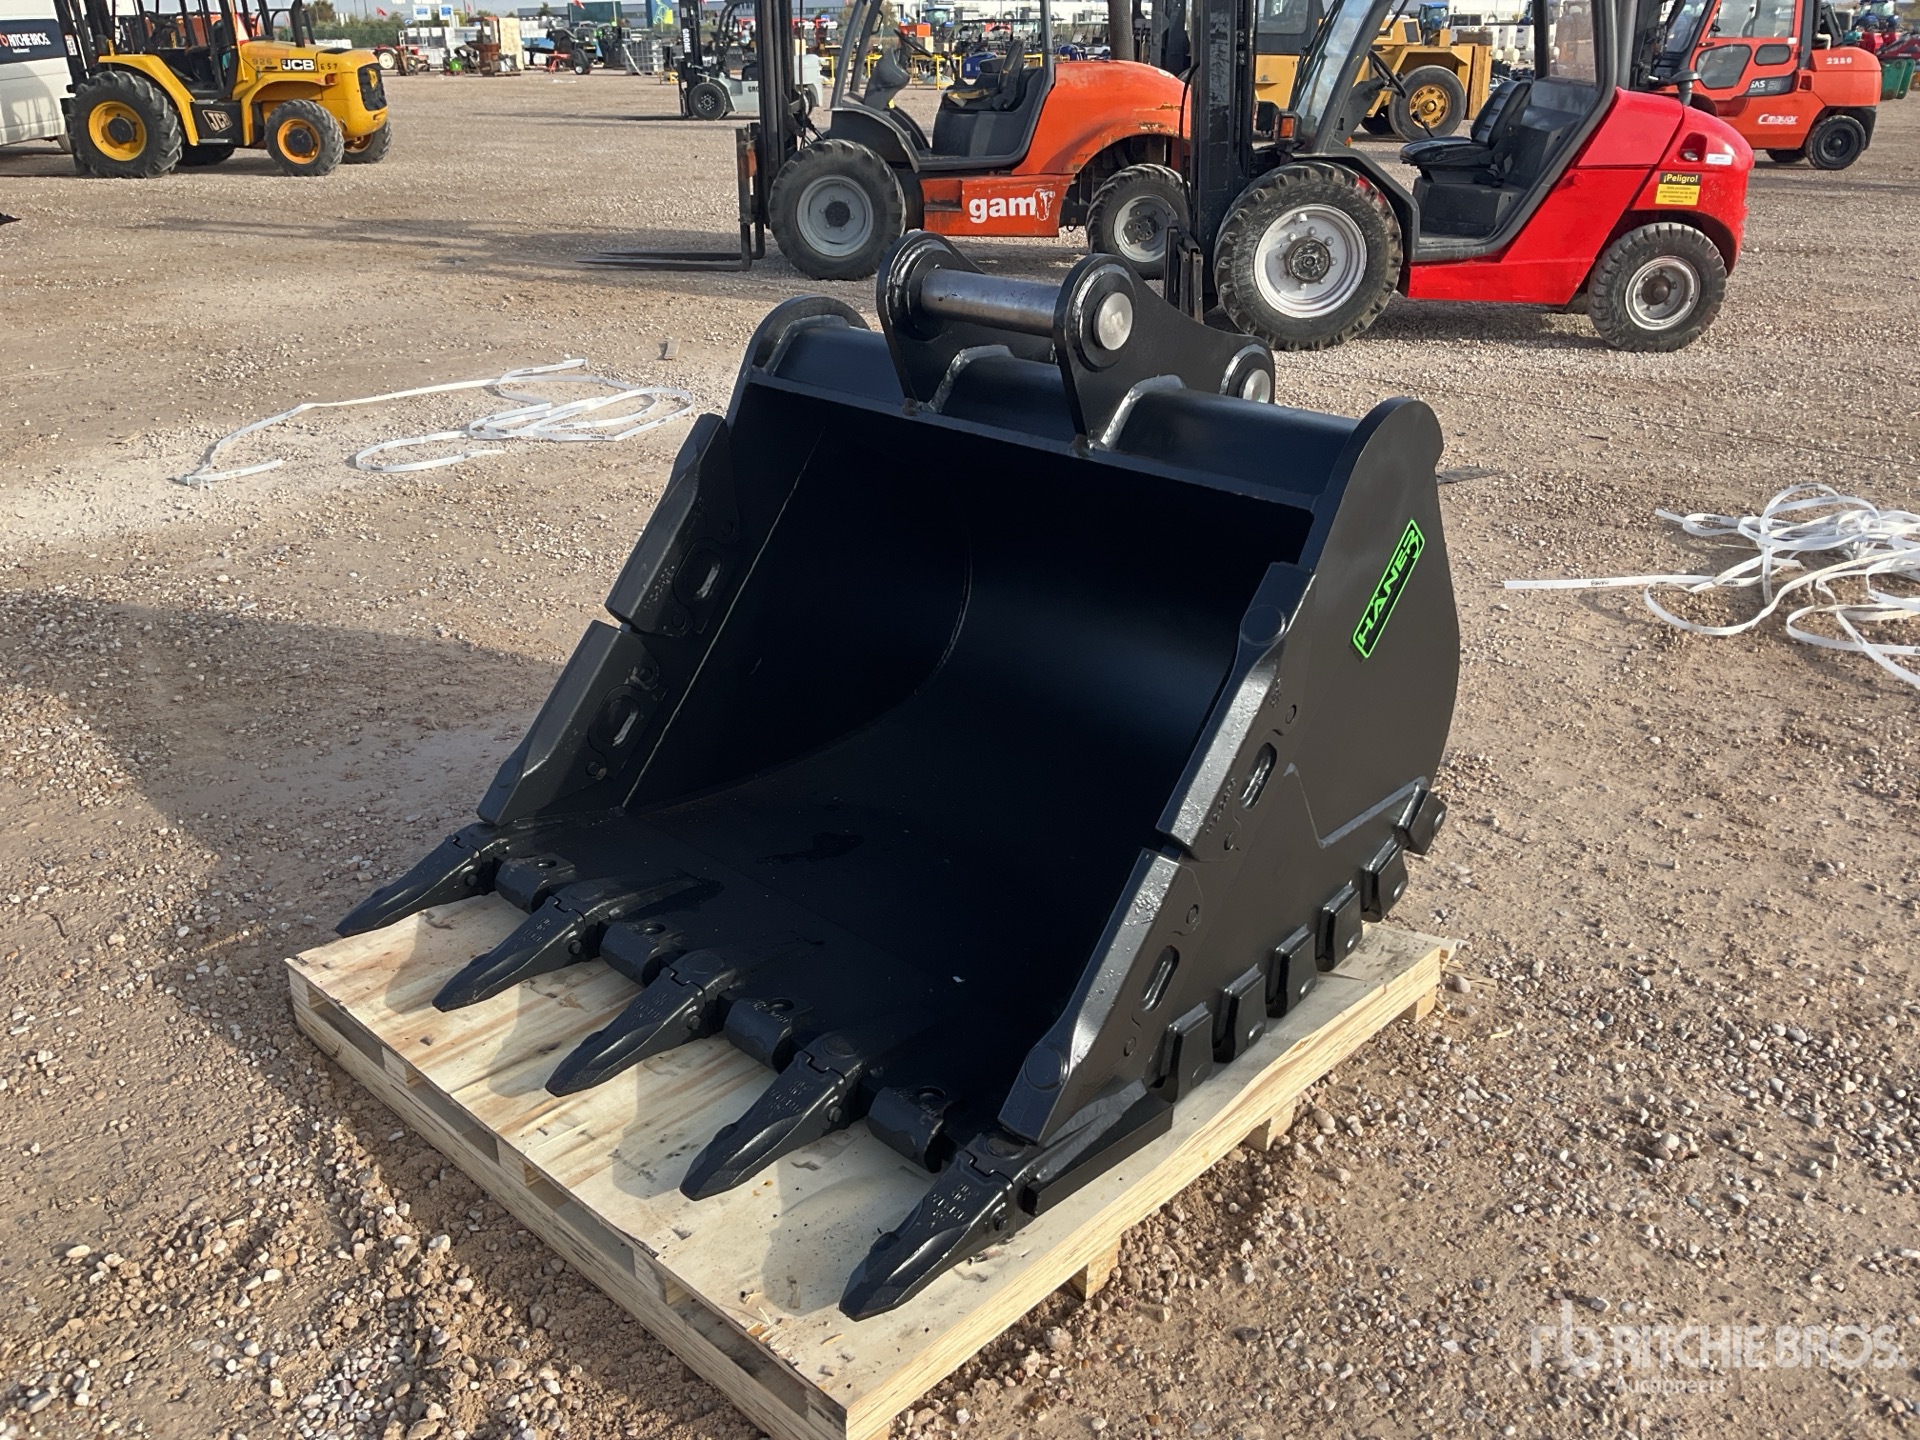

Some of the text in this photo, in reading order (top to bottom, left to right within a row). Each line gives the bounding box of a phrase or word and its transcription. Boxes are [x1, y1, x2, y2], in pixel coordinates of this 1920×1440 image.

[282, 59, 315, 71] JCB
[207, 112, 231, 131] JCB
[1663, 173, 1699, 184] ¡Peligro!
[969, 196, 1037, 224] gam
